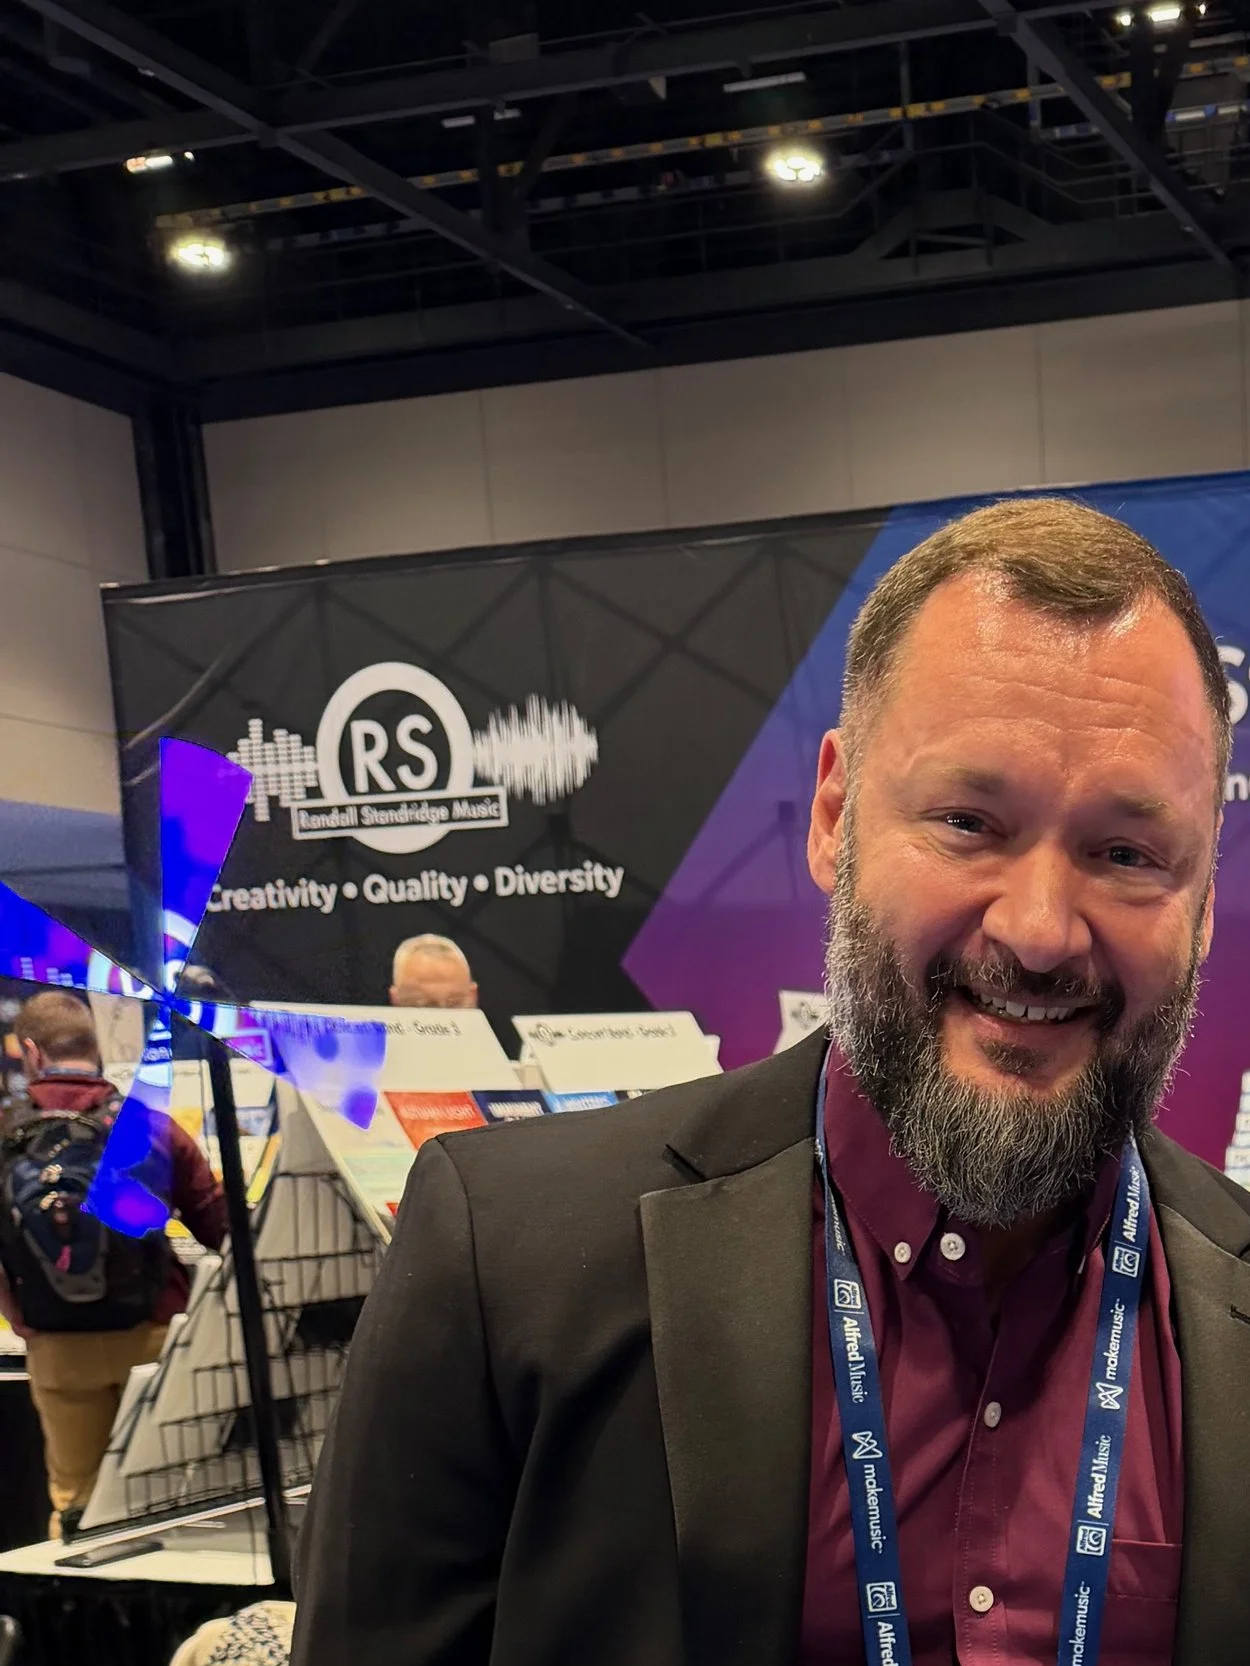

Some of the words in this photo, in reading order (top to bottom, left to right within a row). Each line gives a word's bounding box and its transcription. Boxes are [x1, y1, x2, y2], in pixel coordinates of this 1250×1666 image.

[350, 714, 438, 793] RS
[299, 802, 358, 829] Randall
[361, 799, 448, 826] Standridge
[452, 797, 501, 820] Music
[207, 878, 337, 914] Creativity
[363, 869, 468, 907] Quality
[495, 860, 624, 898] Diversity
[1106, 1301, 1125, 1380] makemusic
[864, 1464, 887, 1550] makemusic
